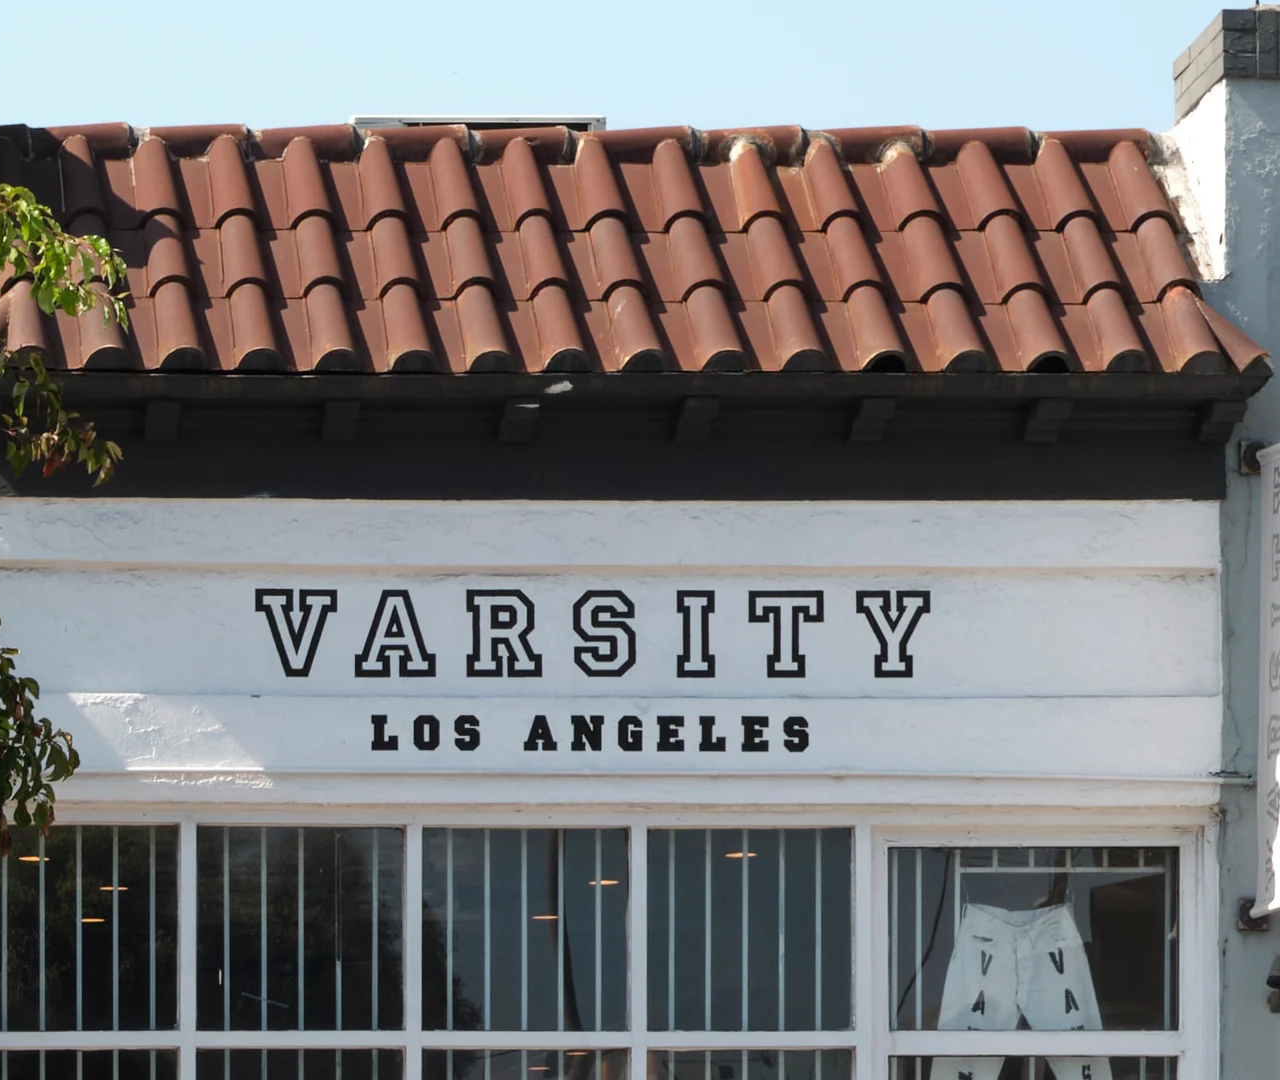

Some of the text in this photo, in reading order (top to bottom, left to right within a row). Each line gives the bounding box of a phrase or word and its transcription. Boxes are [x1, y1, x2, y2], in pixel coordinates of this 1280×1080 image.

[255, 589, 931, 678] VARSITY
[371, 714, 810, 753] LOS ANGELES
